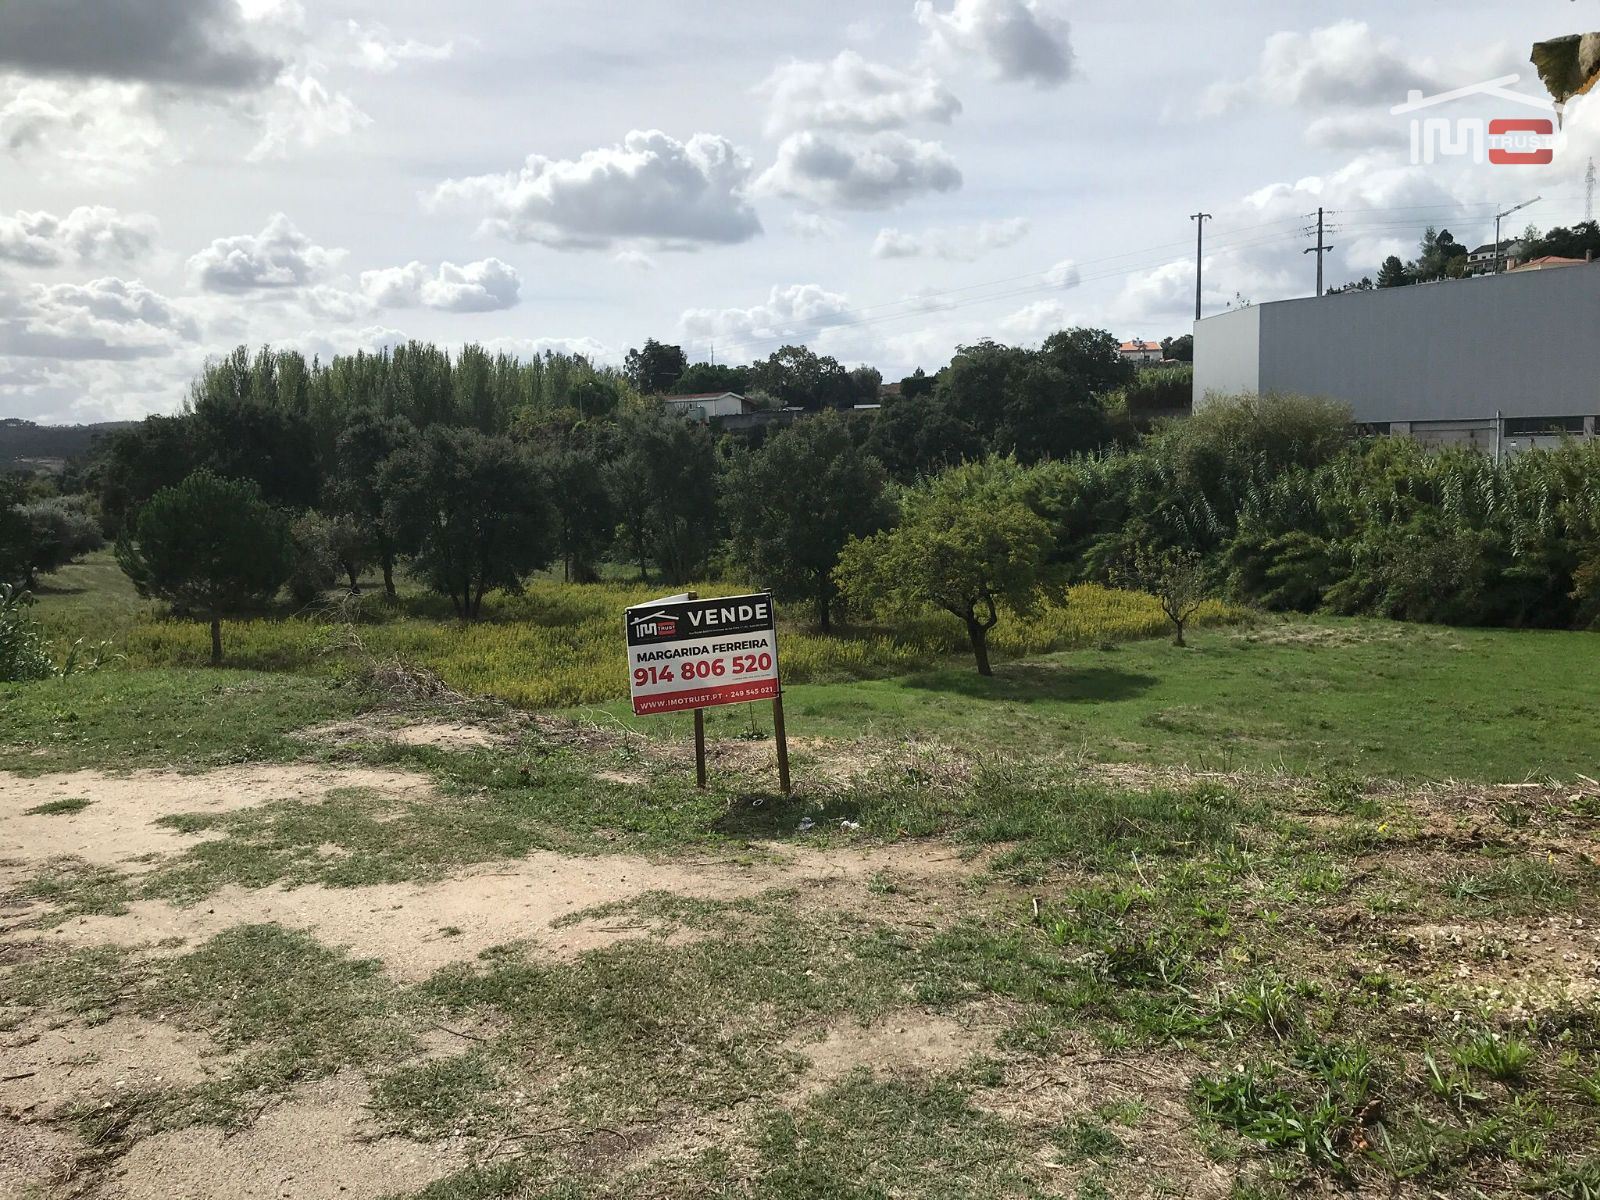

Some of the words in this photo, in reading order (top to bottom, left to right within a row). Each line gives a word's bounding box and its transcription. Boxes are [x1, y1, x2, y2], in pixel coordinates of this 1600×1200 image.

[687, 603, 768, 627] VENDE
[636, 646, 710, 663] MARGARIDA
[712, 638, 769, 653] FERREIRA
[633, 664, 675, 687] 914
[680, 658, 726, 680] 806
[731, 652, 772, 675] 520
[640, 692, 723, 710] WWW.IMOTRUST.PT
[730, 690, 745, 698] 249
[746, 688, 760, 696] 545
[760, 686, 774, 695] 021
